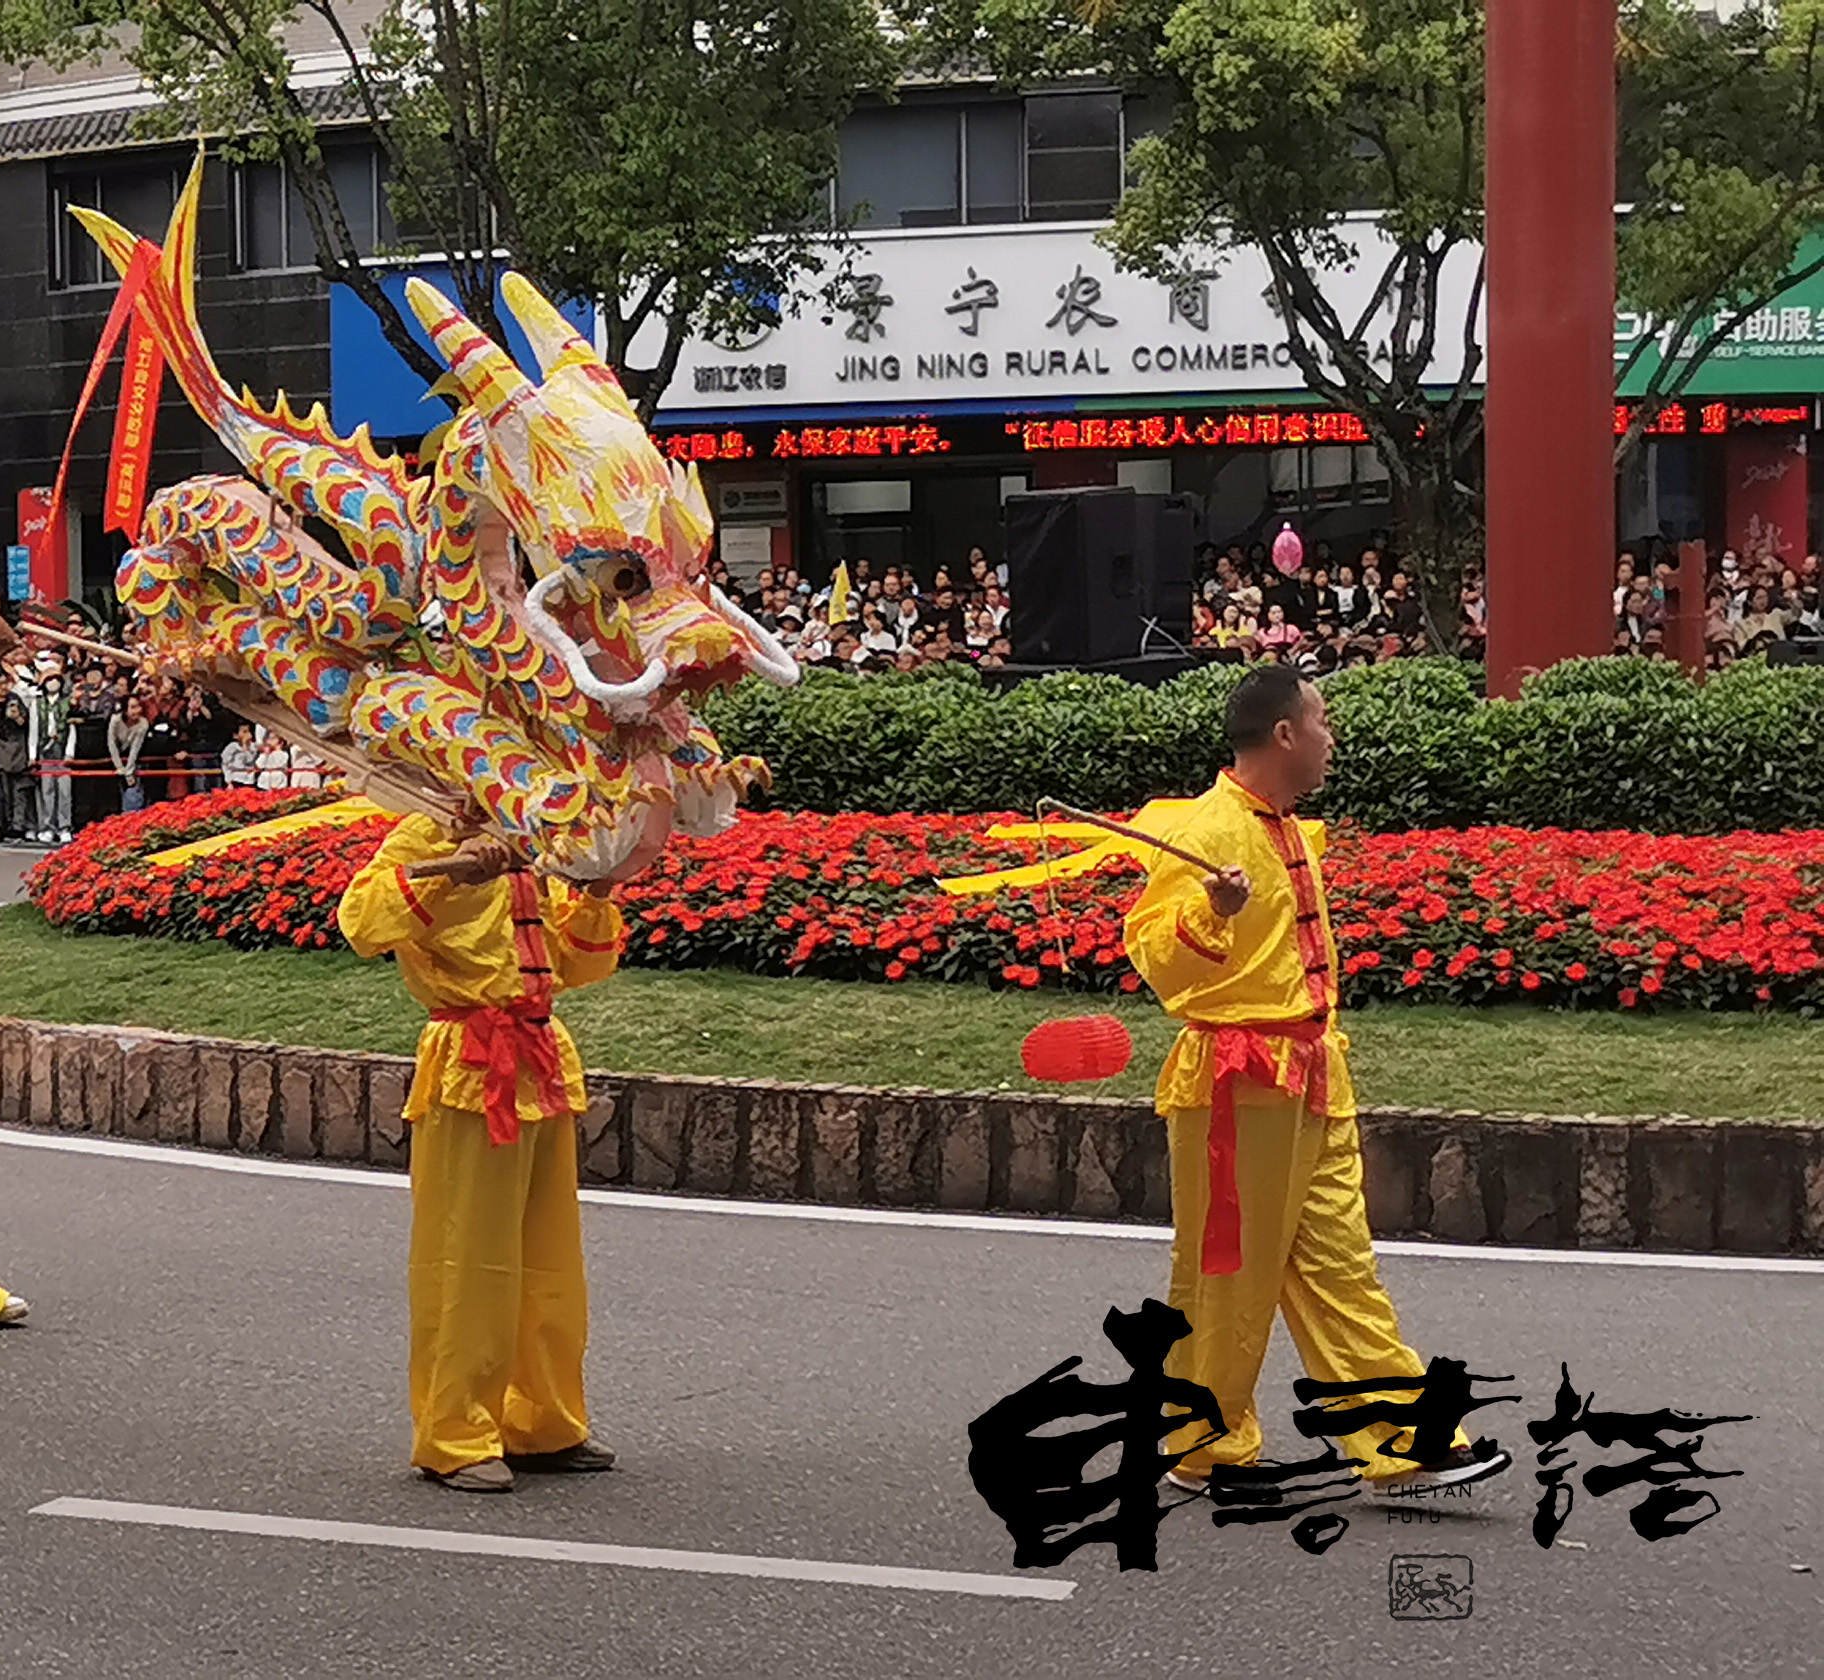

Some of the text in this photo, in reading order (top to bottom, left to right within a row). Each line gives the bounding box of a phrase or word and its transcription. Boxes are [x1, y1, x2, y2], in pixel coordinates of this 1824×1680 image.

[842, 262, 1429, 343] 景宁农商
[1713, 305, 1824, 343] 自助服
[693, 363, 787, 393] 浙江农信
[835, 354, 901, 382] JING
[917, 351, 989, 379] NING
[1005, 347, 1111, 376] RURAL
[1130, 338, 1337, 372] COMMERCAL
